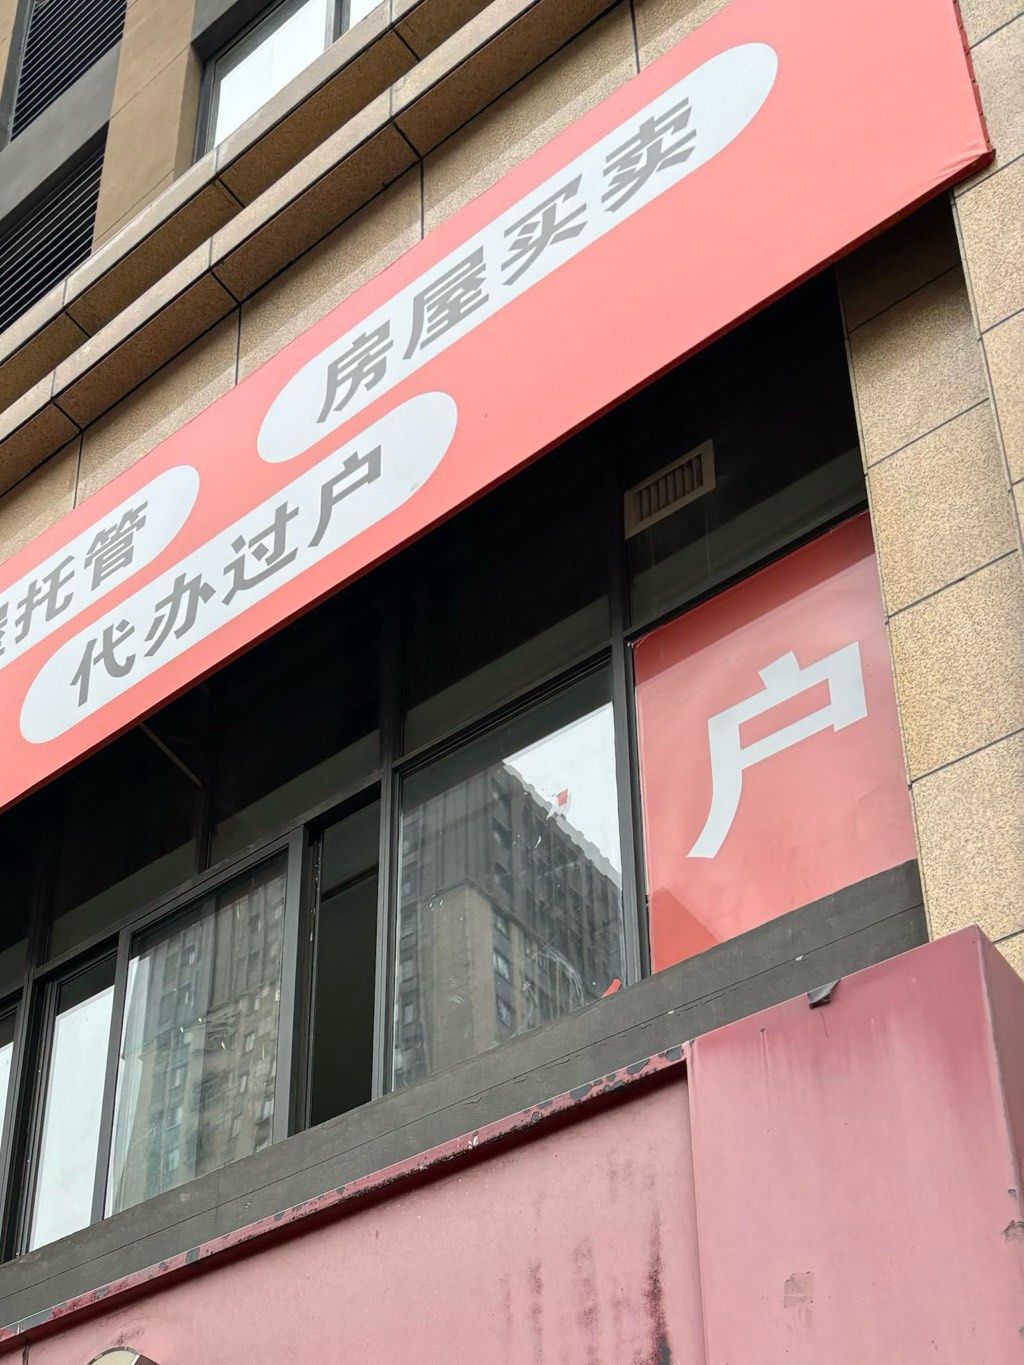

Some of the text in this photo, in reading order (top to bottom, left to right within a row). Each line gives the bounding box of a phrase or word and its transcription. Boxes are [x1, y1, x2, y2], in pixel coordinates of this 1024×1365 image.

[316, 95, 697, 424] 房屋买卖
[69, 443, 383, 706] 代办过户
[687, 641, 868, 859] 户
